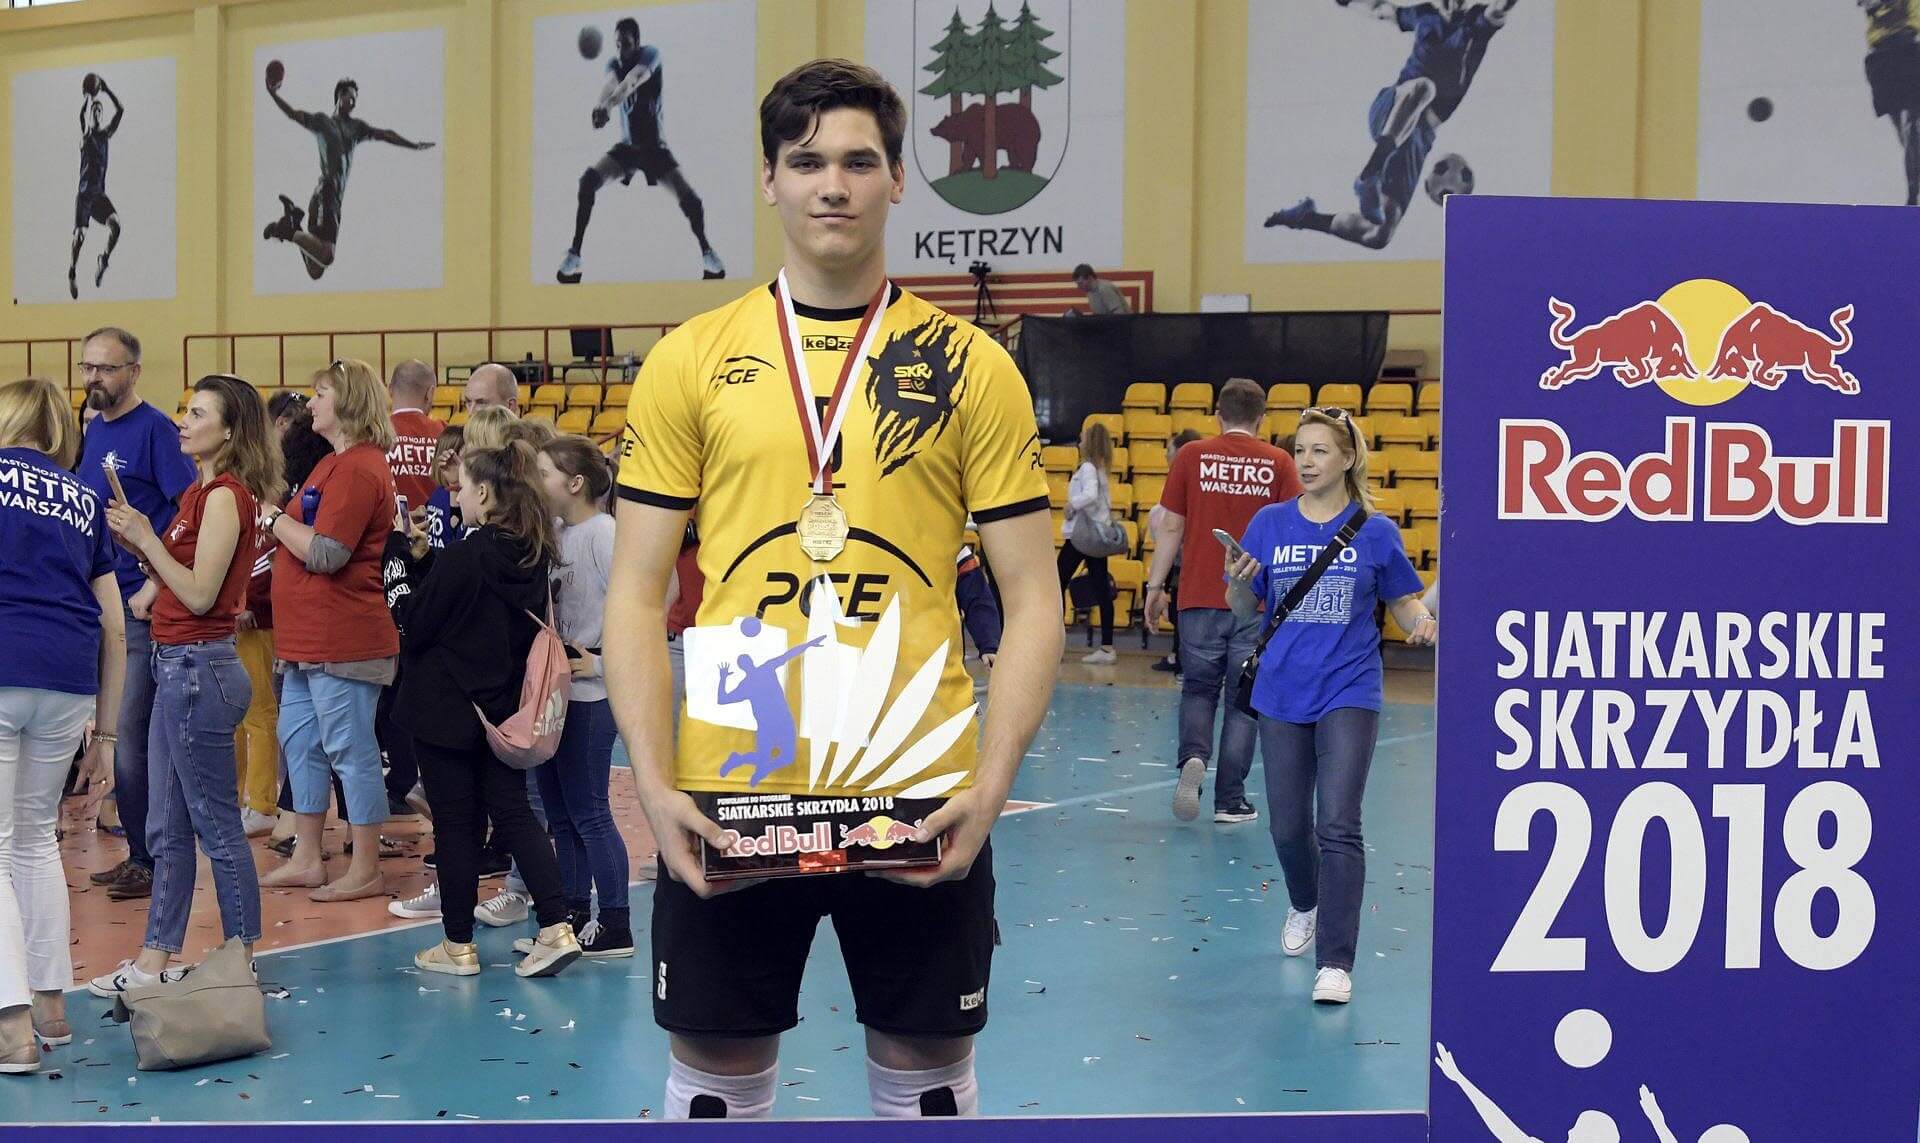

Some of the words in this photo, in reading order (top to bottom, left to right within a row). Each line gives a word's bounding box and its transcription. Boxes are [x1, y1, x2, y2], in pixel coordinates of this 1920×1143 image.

[915, 226, 1063, 264] KĘTRZYN
[385, 445, 436, 463] METR
[1200, 462, 1275, 484] METRO
[1498, 416, 1695, 522] Red
[1704, 419, 1890, 525] Bull
[0, 467, 95, 522] METRO
[1200, 481, 1271, 498] WARSZAWA
[1495, 610, 1885, 679] SIATKARSKIE
[1494, 688, 1880, 770] SKRZYDŁA
[718, 804, 794, 821] SIATKARSKIE
[796, 799, 859, 816] SKRZYDŁA
[862, 796, 894, 811] 2018
[720, 825, 777, 857] Red
[777, 822, 832, 853] Bull
[1489, 780, 1876, 973] 2018
